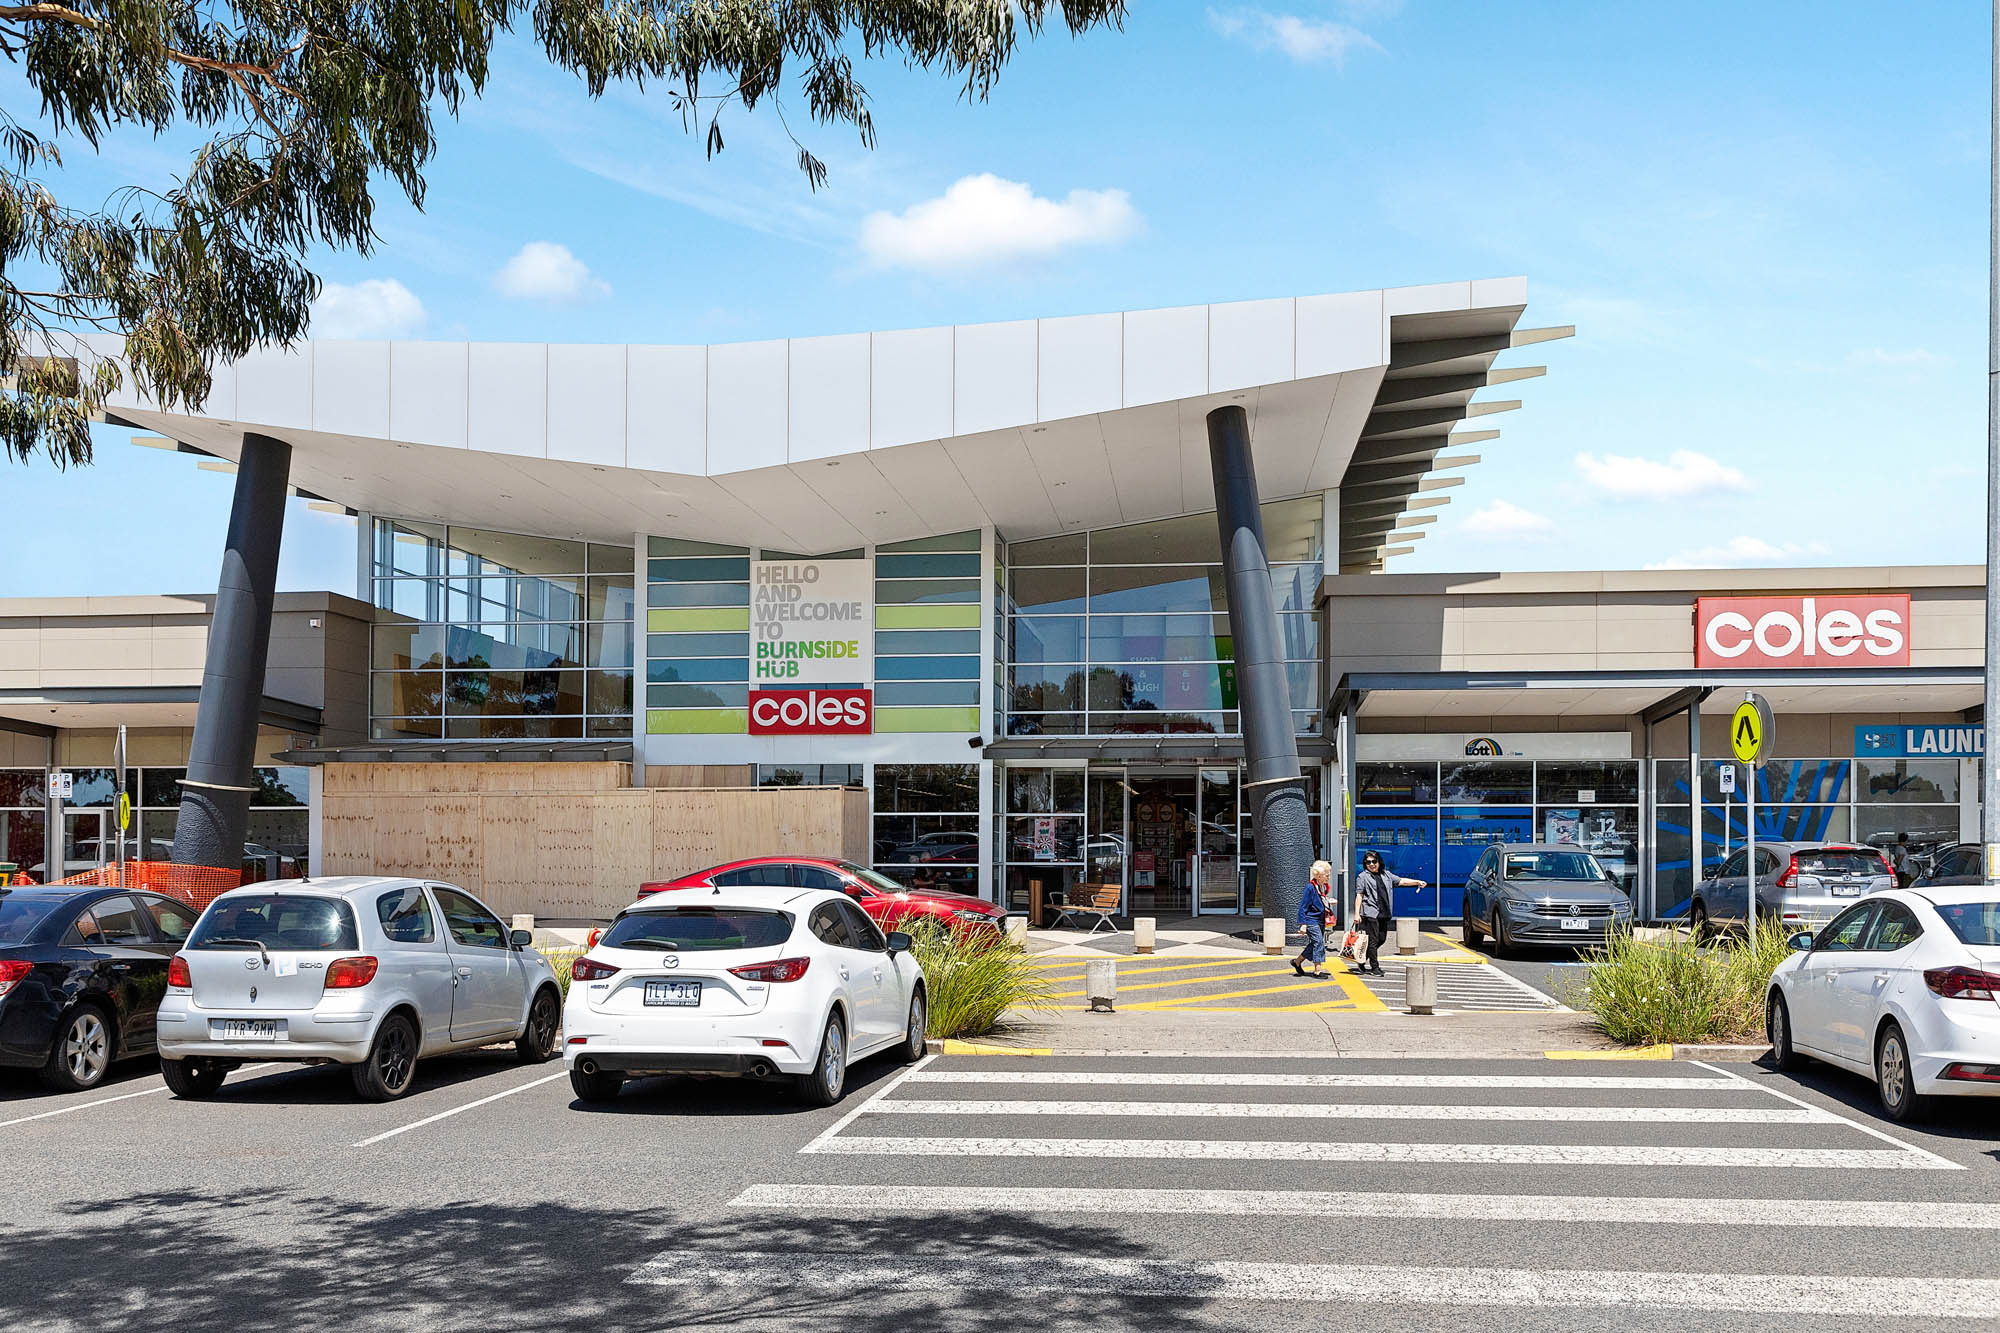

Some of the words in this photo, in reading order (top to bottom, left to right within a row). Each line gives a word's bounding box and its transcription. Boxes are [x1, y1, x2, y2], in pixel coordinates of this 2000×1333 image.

[756, 566, 819, 584] HELLO
[755, 585, 801, 603] AND
[755, 602, 862, 622] WELCOME
[755, 621, 783, 641] TO
[1705, 597, 1905, 658] coles
[752, 691, 867, 727] coles
[1465, 745, 1490, 756] Lott
[227, 1023, 246, 1036] 1YR
[254, 1023, 274, 1036] 9MW
